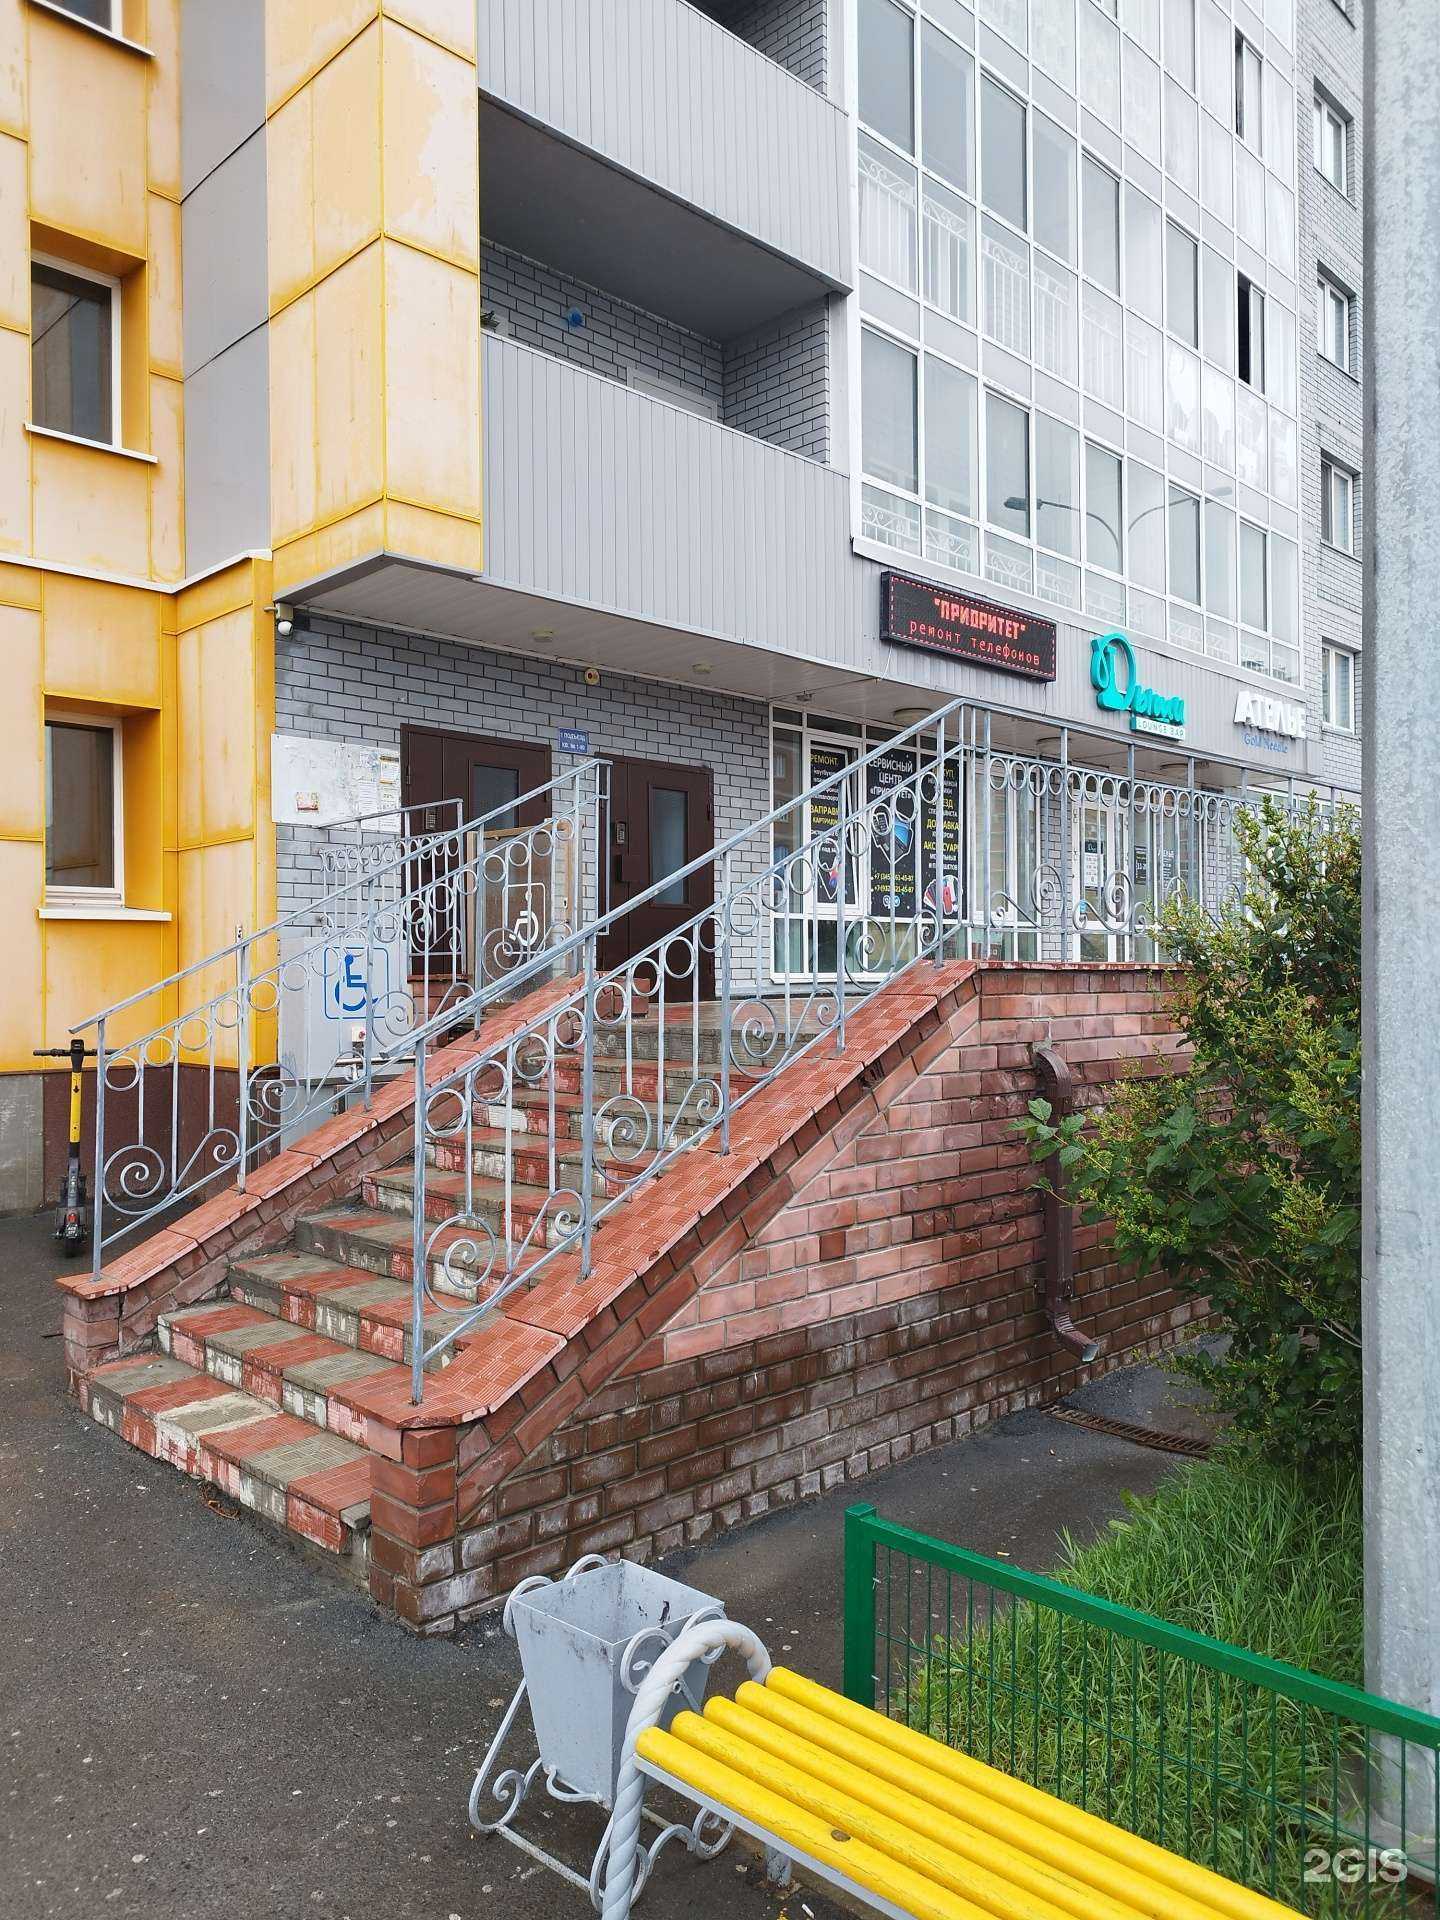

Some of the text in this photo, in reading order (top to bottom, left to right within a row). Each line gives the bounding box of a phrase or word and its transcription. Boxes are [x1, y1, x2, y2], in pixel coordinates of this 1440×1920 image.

[910, 621, 1040, 666] ремонт телефонов
[811, 754, 838, 766] РЕМОНТ
[869, 757, 913, 773] СЕРВИСНЫЙ
[879, 772, 903, 785] ЦЕНТР
[926, 818, 960, 831] ДОАВКА
